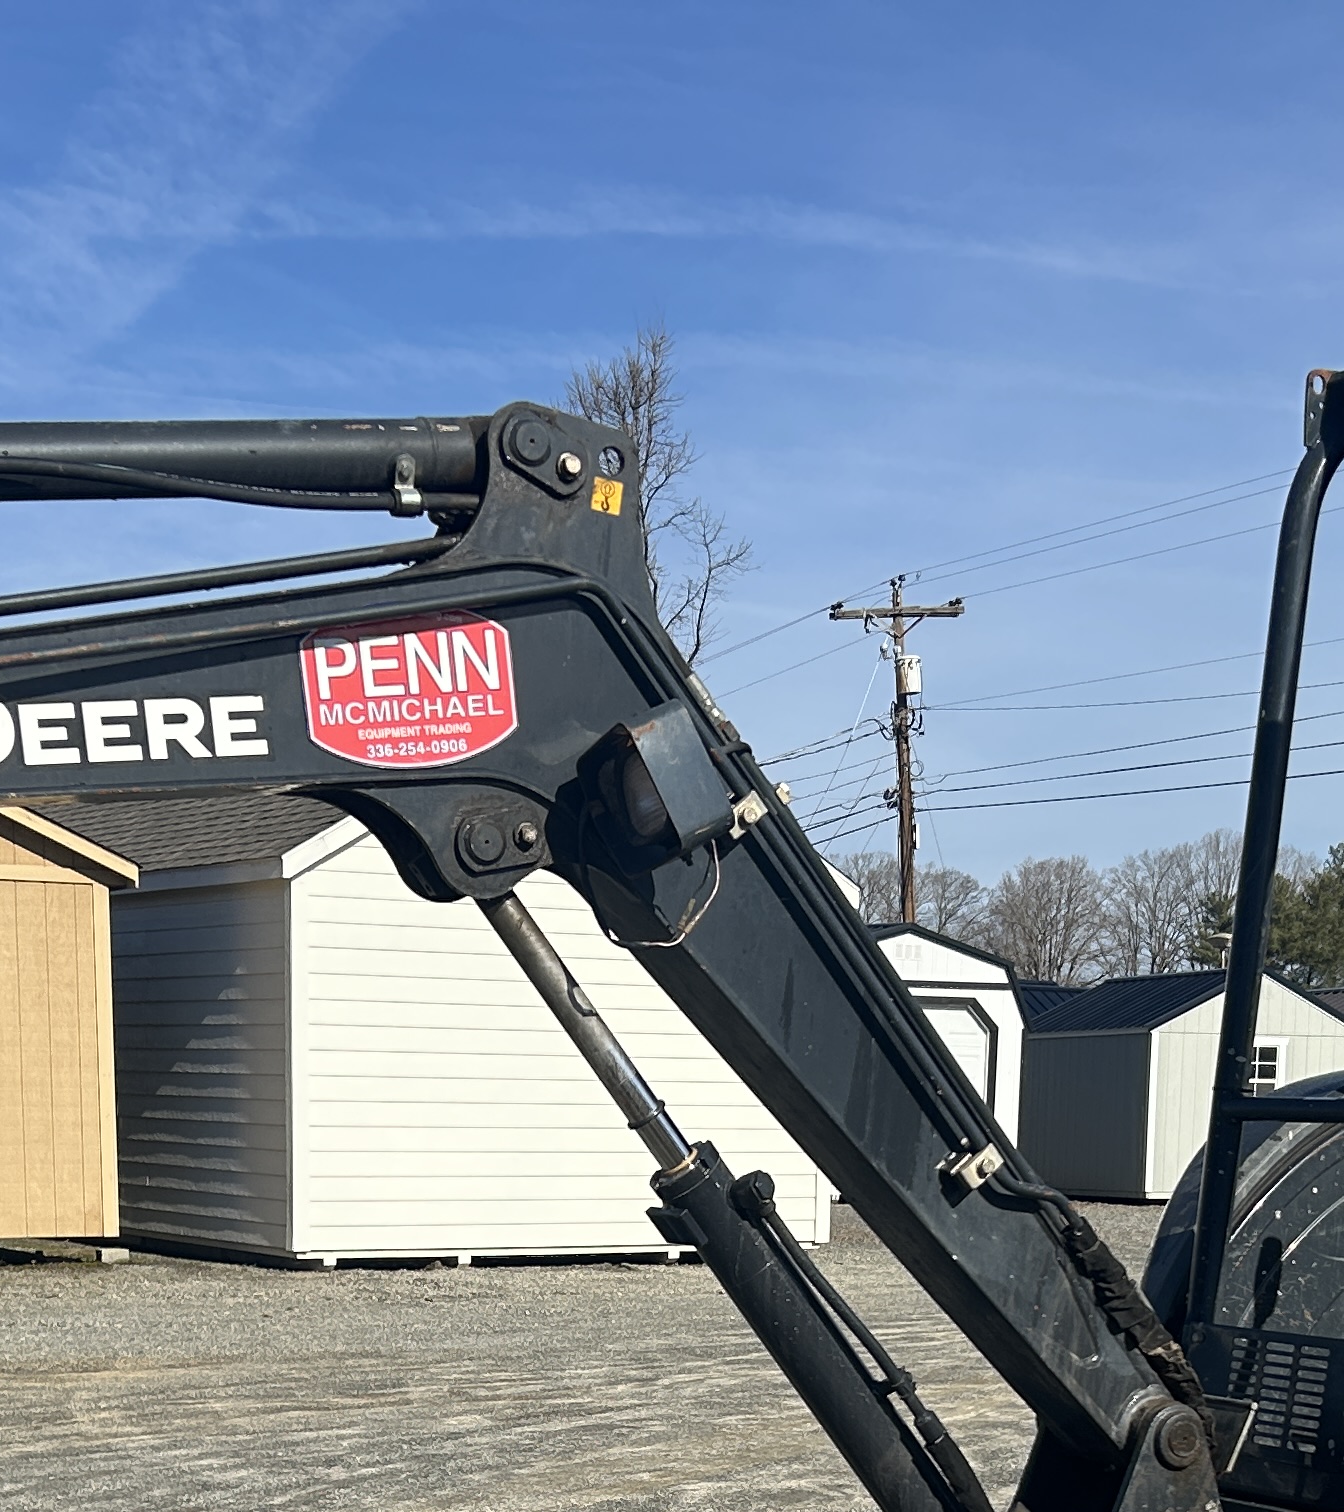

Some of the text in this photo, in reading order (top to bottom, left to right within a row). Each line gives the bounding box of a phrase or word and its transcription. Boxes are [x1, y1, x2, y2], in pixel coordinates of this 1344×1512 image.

[313, 629, 501, 700] PENN
[319, 694, 504, 726] MCMICHAEL
[358, 722, 472, 740] EQUIPMENT TRADING
[366, 738, 468, 758] 336-254-0906
